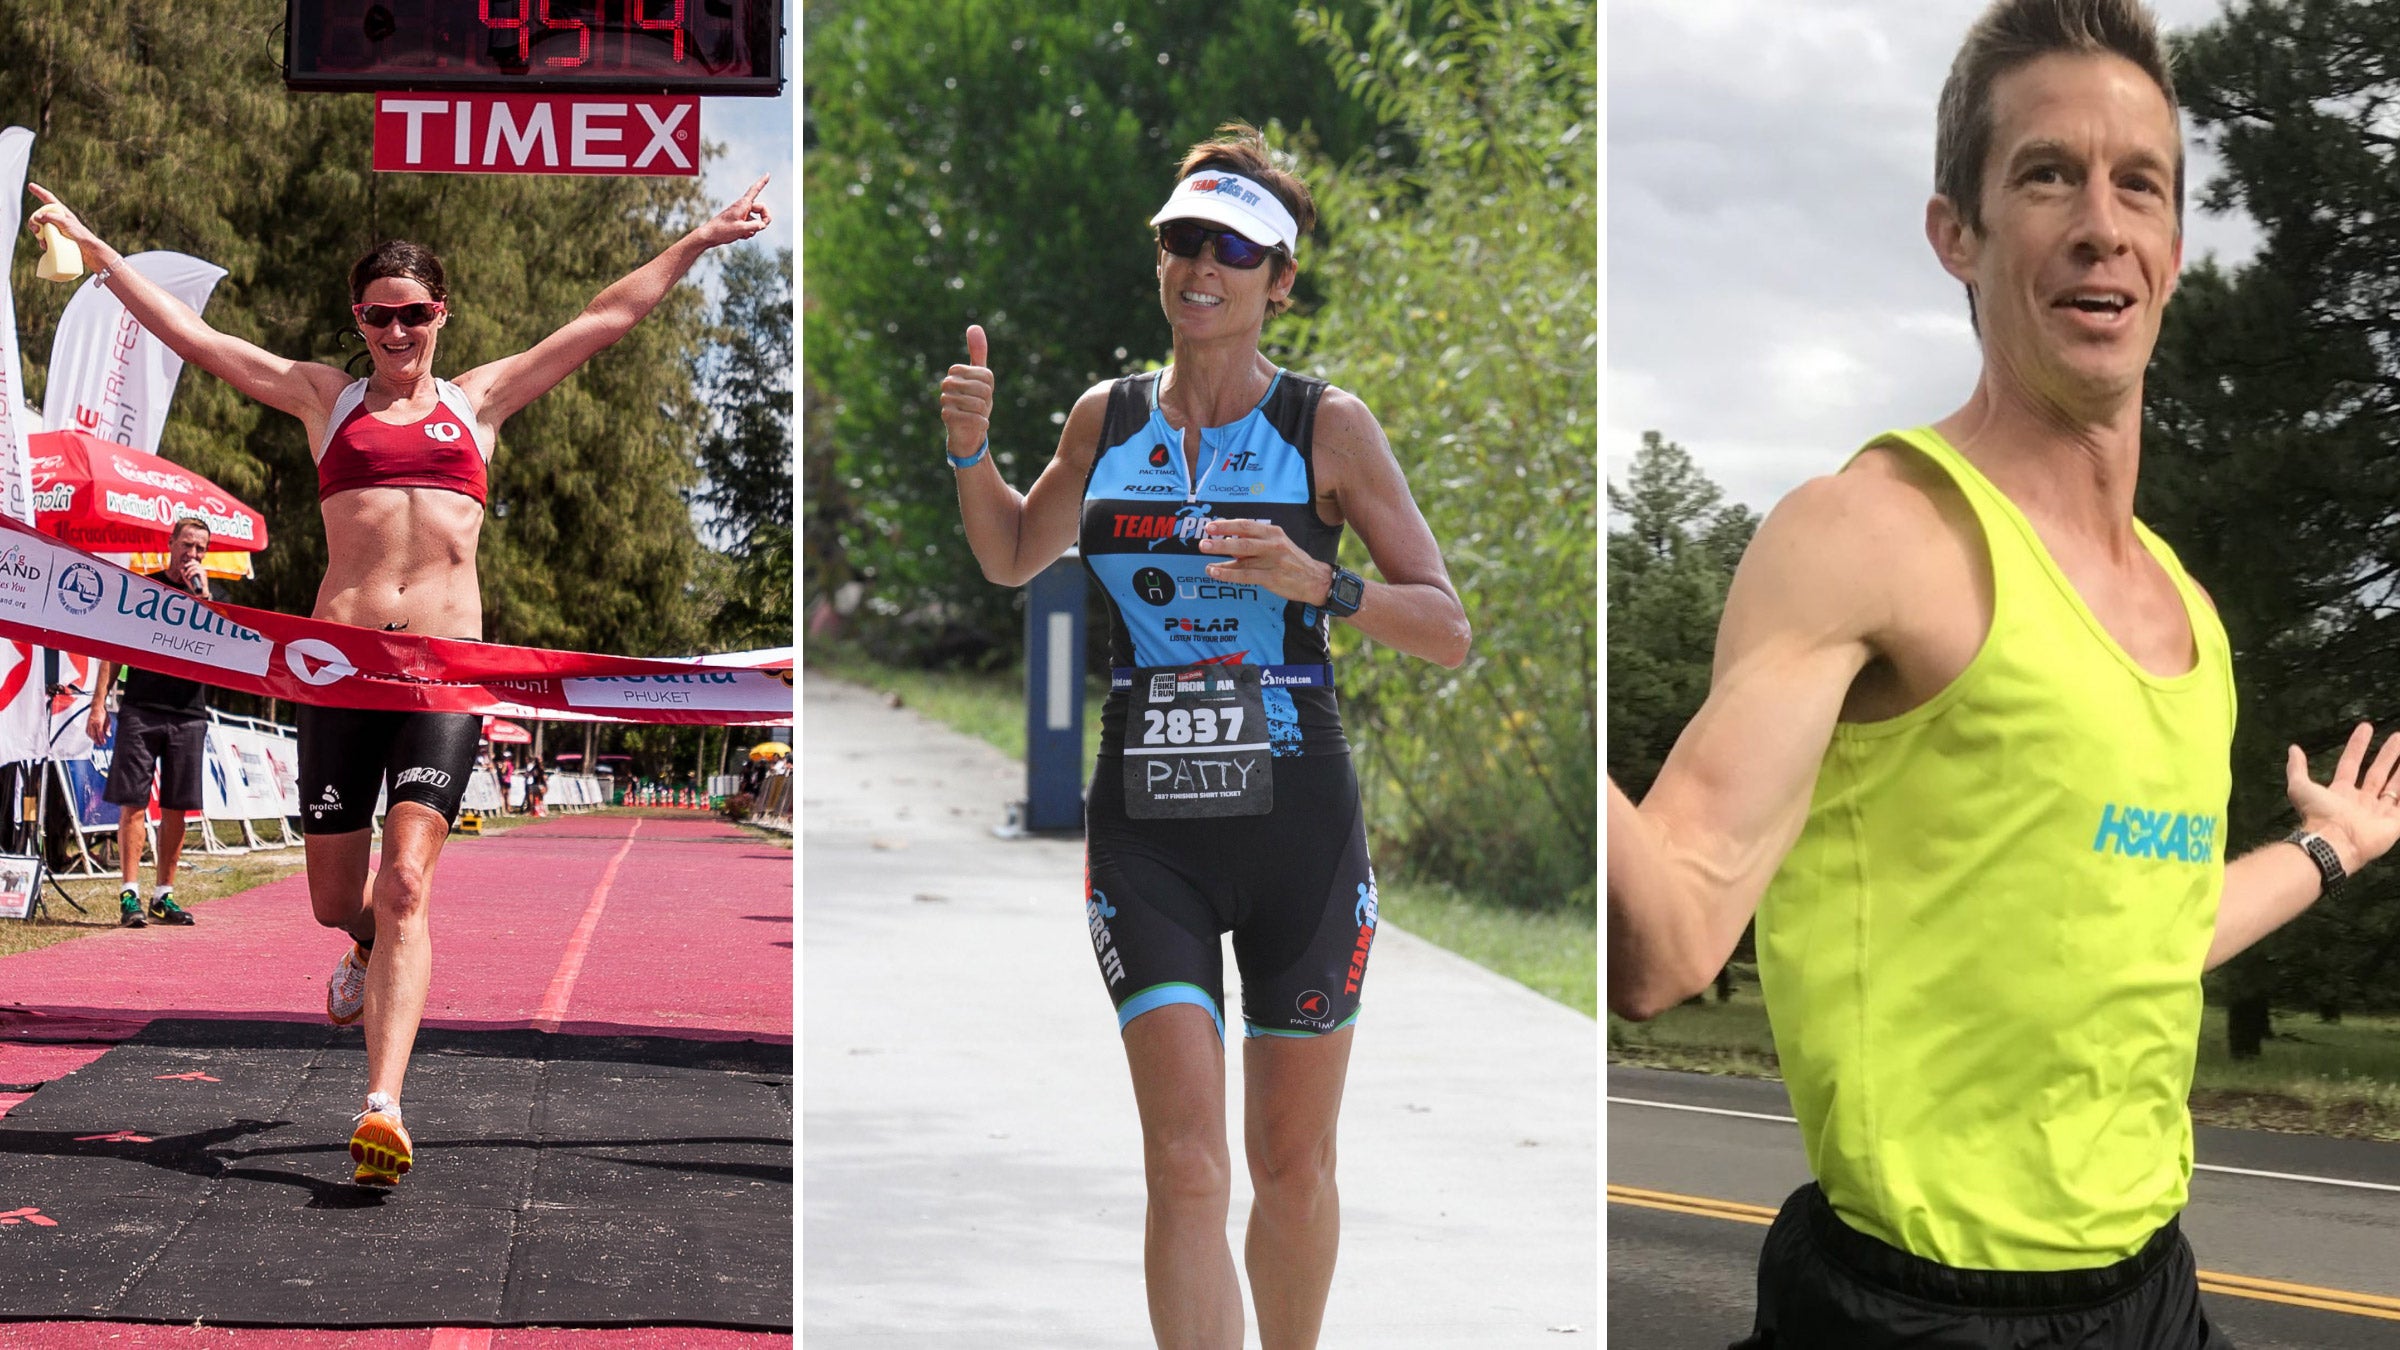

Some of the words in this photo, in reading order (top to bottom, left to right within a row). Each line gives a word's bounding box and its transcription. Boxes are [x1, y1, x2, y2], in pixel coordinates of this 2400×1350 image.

[381, 99, 693, 168] TIMEX
[1190, 179, 1218, 192] TEAM
[1123, 485, 1178, 493] RUDY
[1113, 514, 1177, 538] TEAM
[1165, 618, 1239, 632] POLAR
[152, 632, 215, 656] PHUKET
[1202, 635, 1219, 643] YOUR
[1220, 635, 1237, 643] BODY
[1154, 675, 1174, 683] SWIM
[1275, 675, 1311, 685] Tri-Gal.com
[624, 690, 692, 704] PHUKET
[1143, 707, 1244, 744] 2837
[1147, 758, 1255, 792] PATTY
[2093, 804, 2189, 862] HOKA
[1087, 902, 1111, 953] PRS
[1102, 947, 1126, 986] FIT
[1344, 924, 1374, 996] TEAM
[1290, 1018, 1335, 1029] PACTIMO
